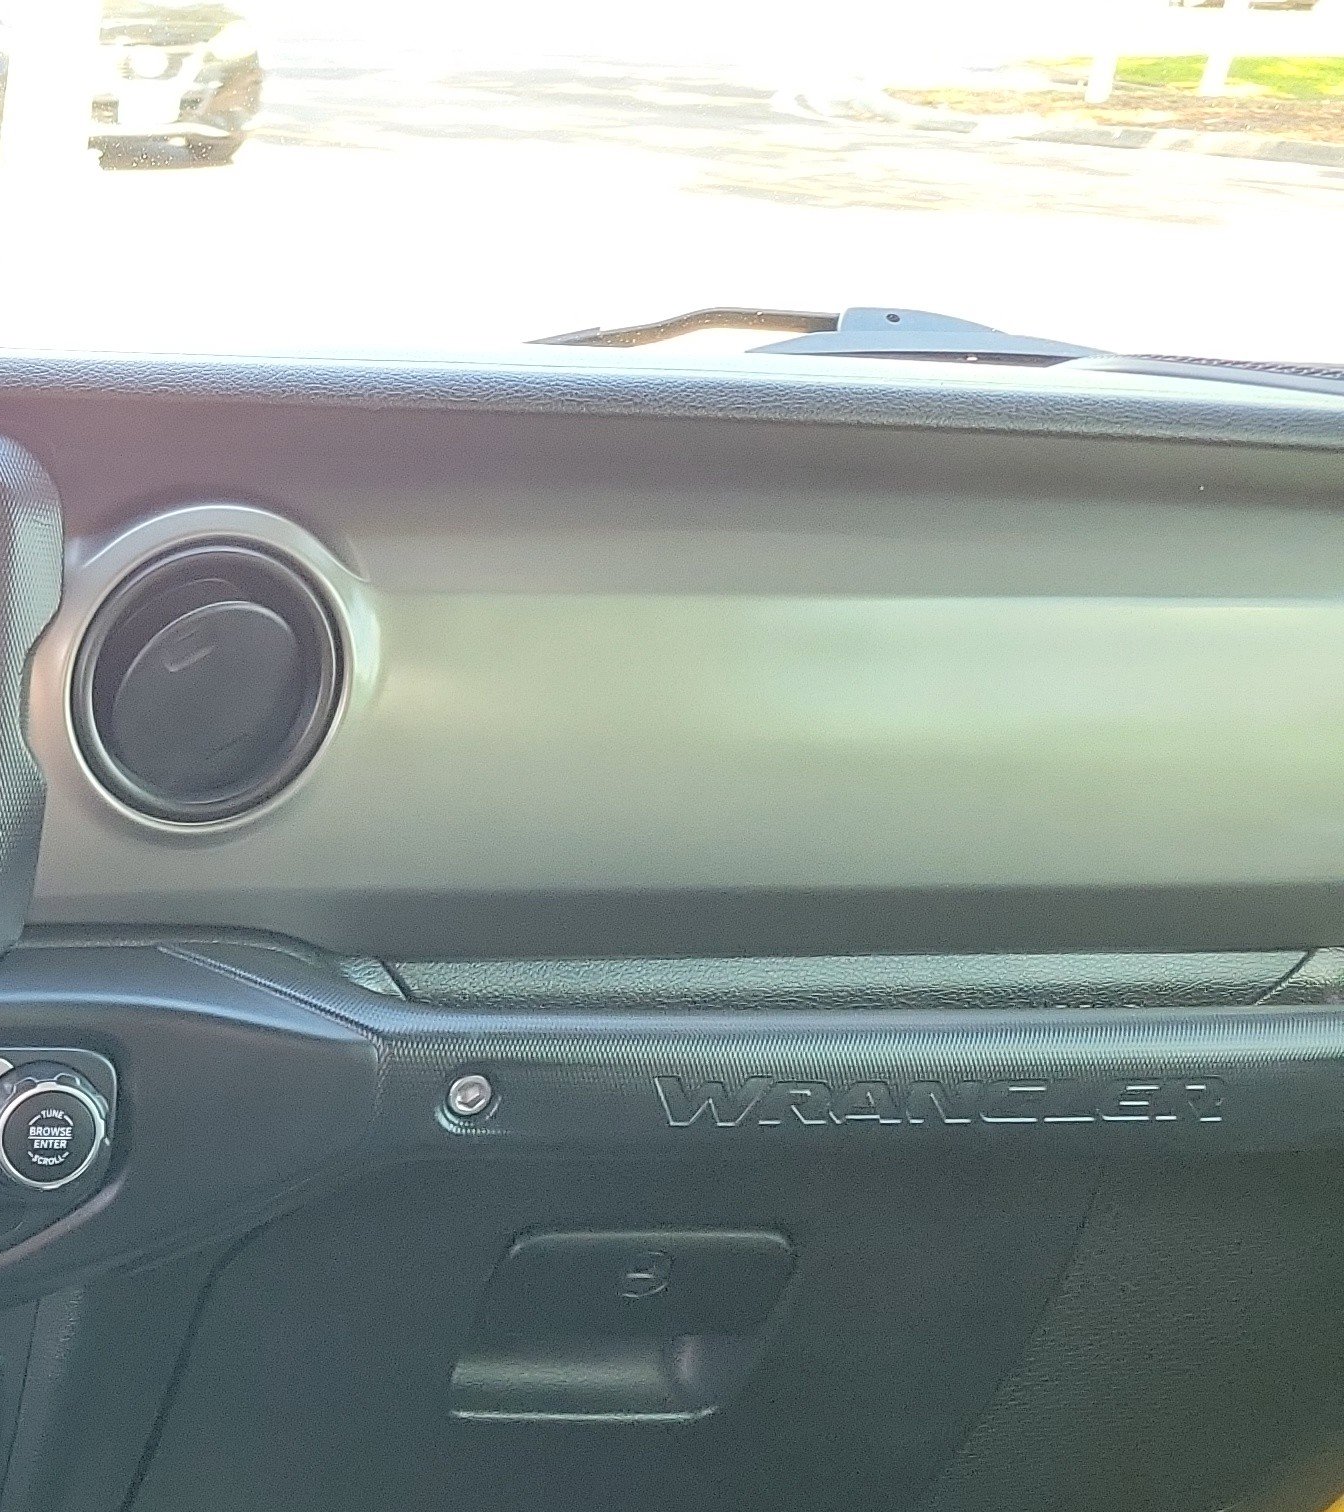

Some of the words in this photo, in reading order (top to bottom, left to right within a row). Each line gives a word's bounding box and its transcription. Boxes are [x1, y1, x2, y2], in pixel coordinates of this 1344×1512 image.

[653, 1073, 1223, 1128] WRANGLER
[40, 1109, 65, 1120] TUNE
[29, 1126, 73, 1137] BROWSE
[33, 1139, 67, 1149] ENTER
[32, 1155, 65, 1166] SCROLL
